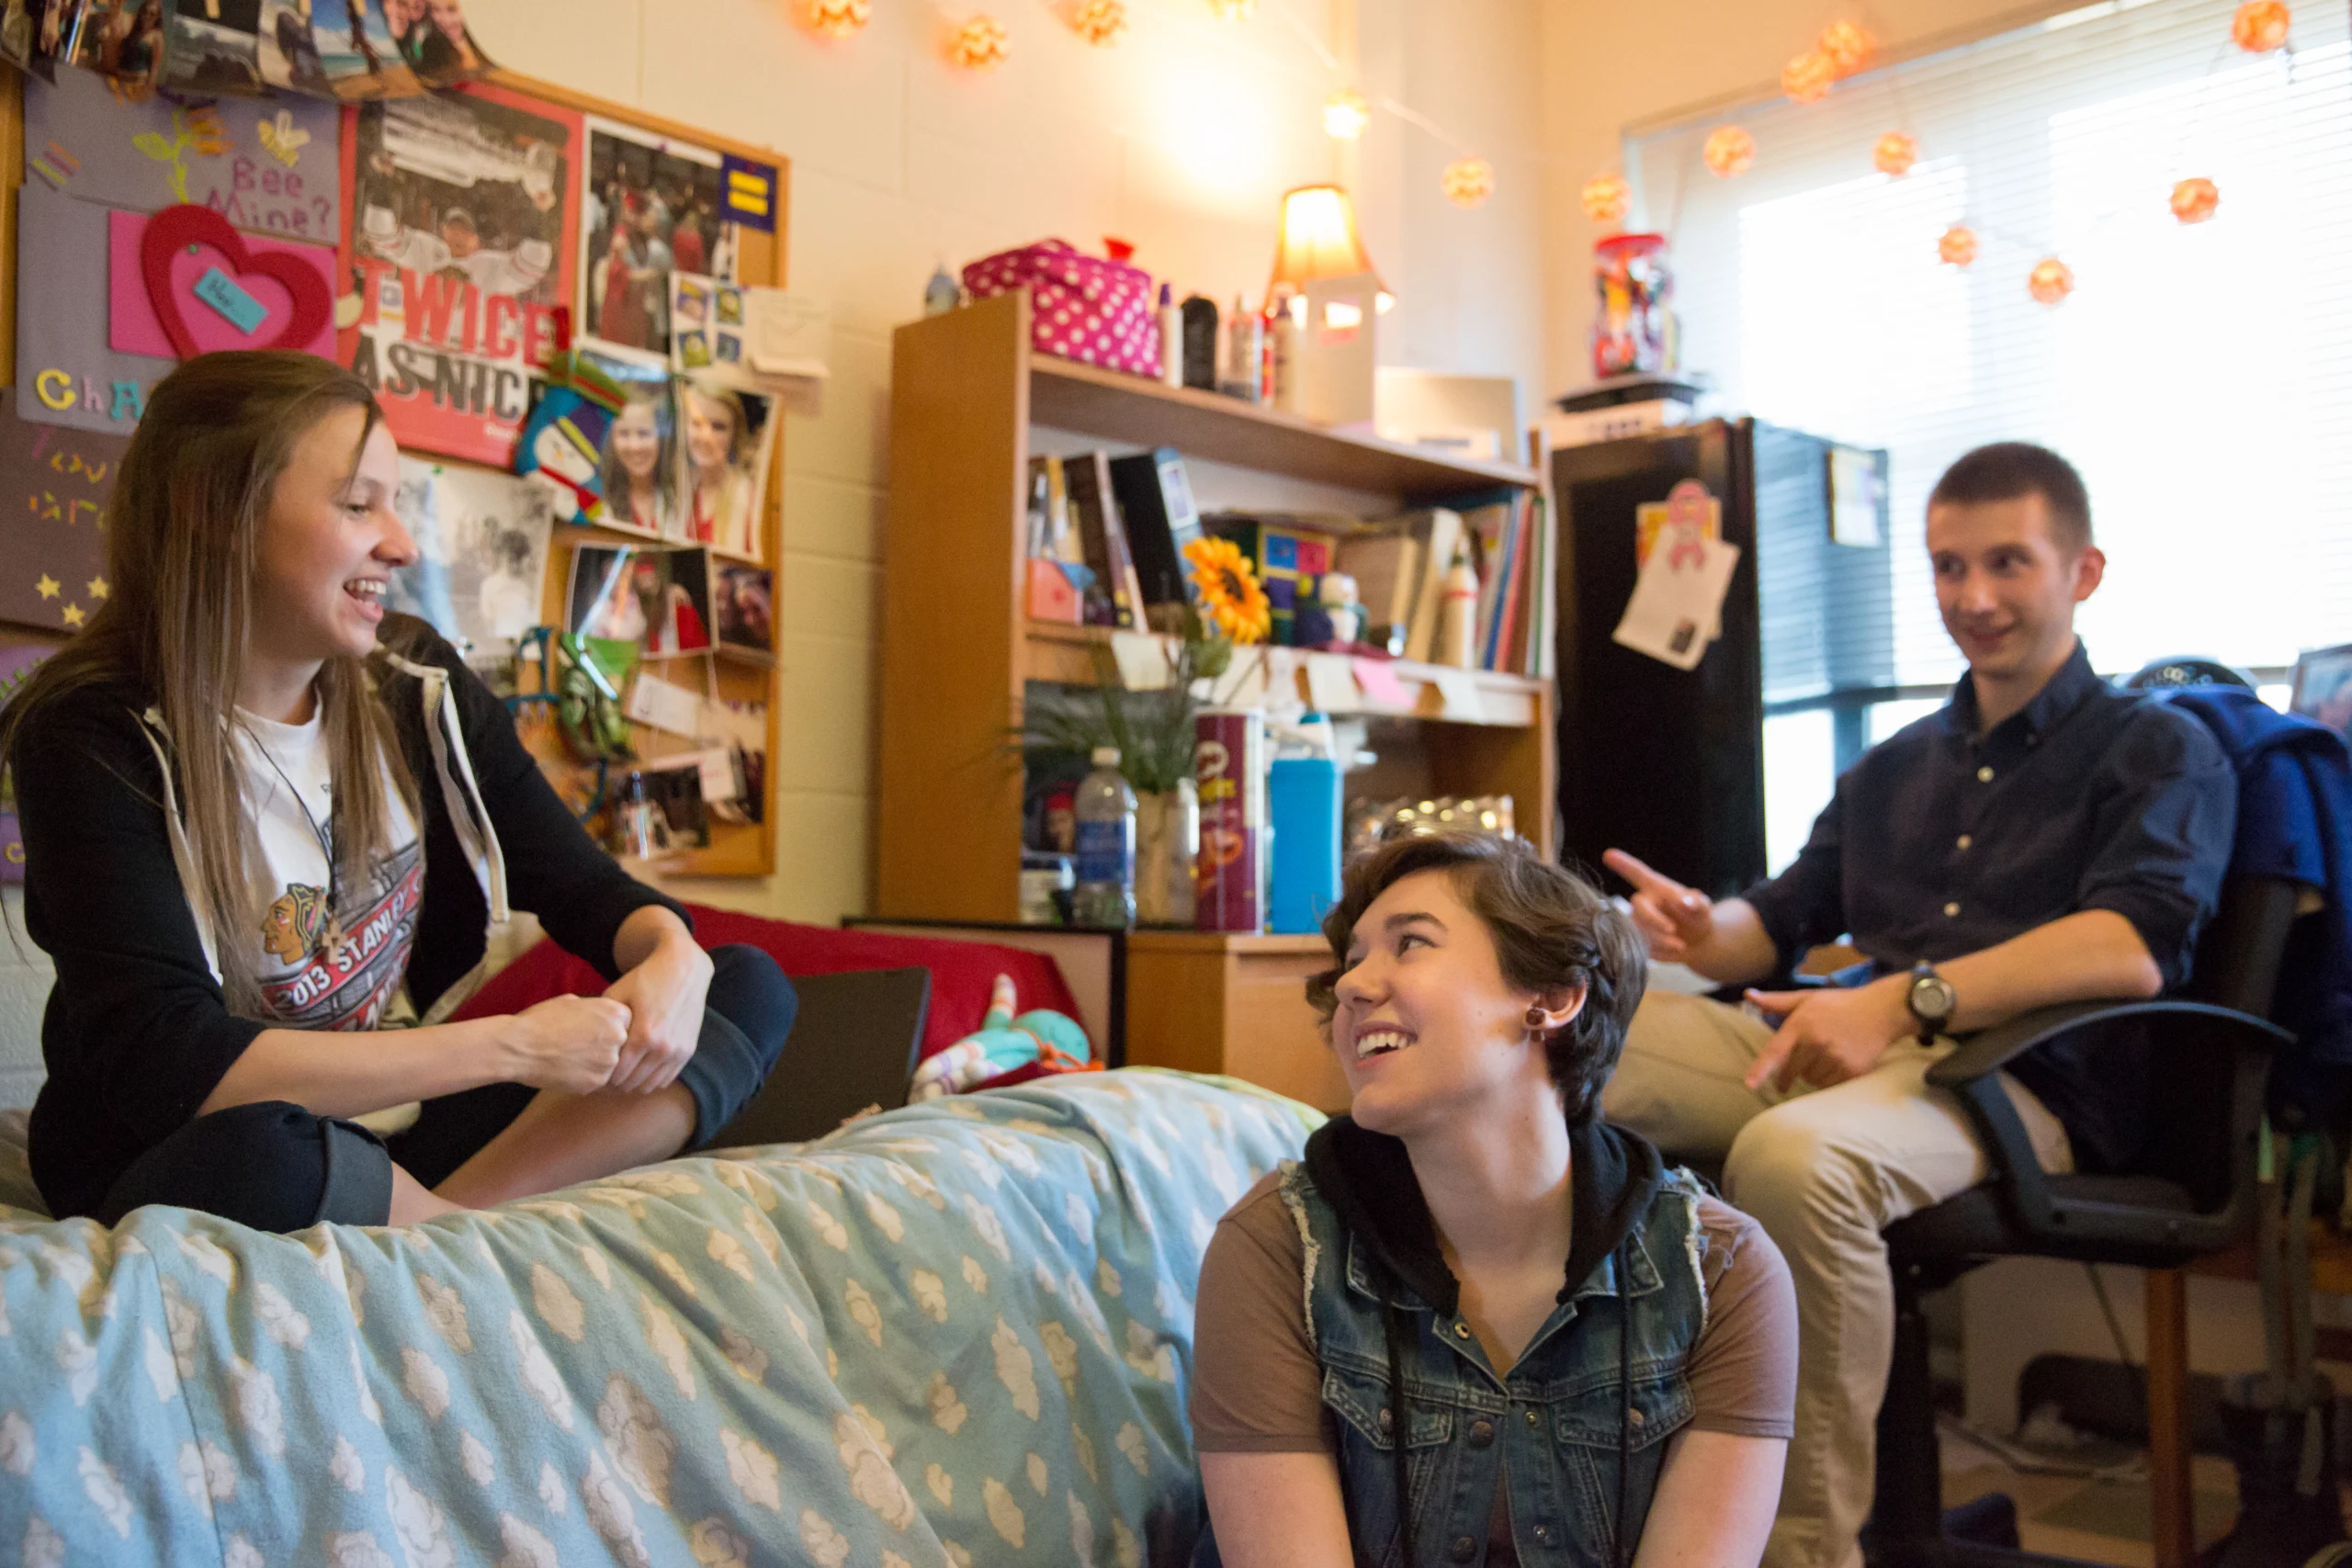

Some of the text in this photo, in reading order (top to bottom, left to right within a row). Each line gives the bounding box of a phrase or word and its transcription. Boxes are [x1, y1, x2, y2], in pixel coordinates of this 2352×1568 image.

[232, 155, 305, 199] Bee
[207, 187, 333, 236] Mine?
[354, 254, 557, 369] TWICE
[37, 368, 154, 420] ChA
[275, 964, 332, 1009] 2013
